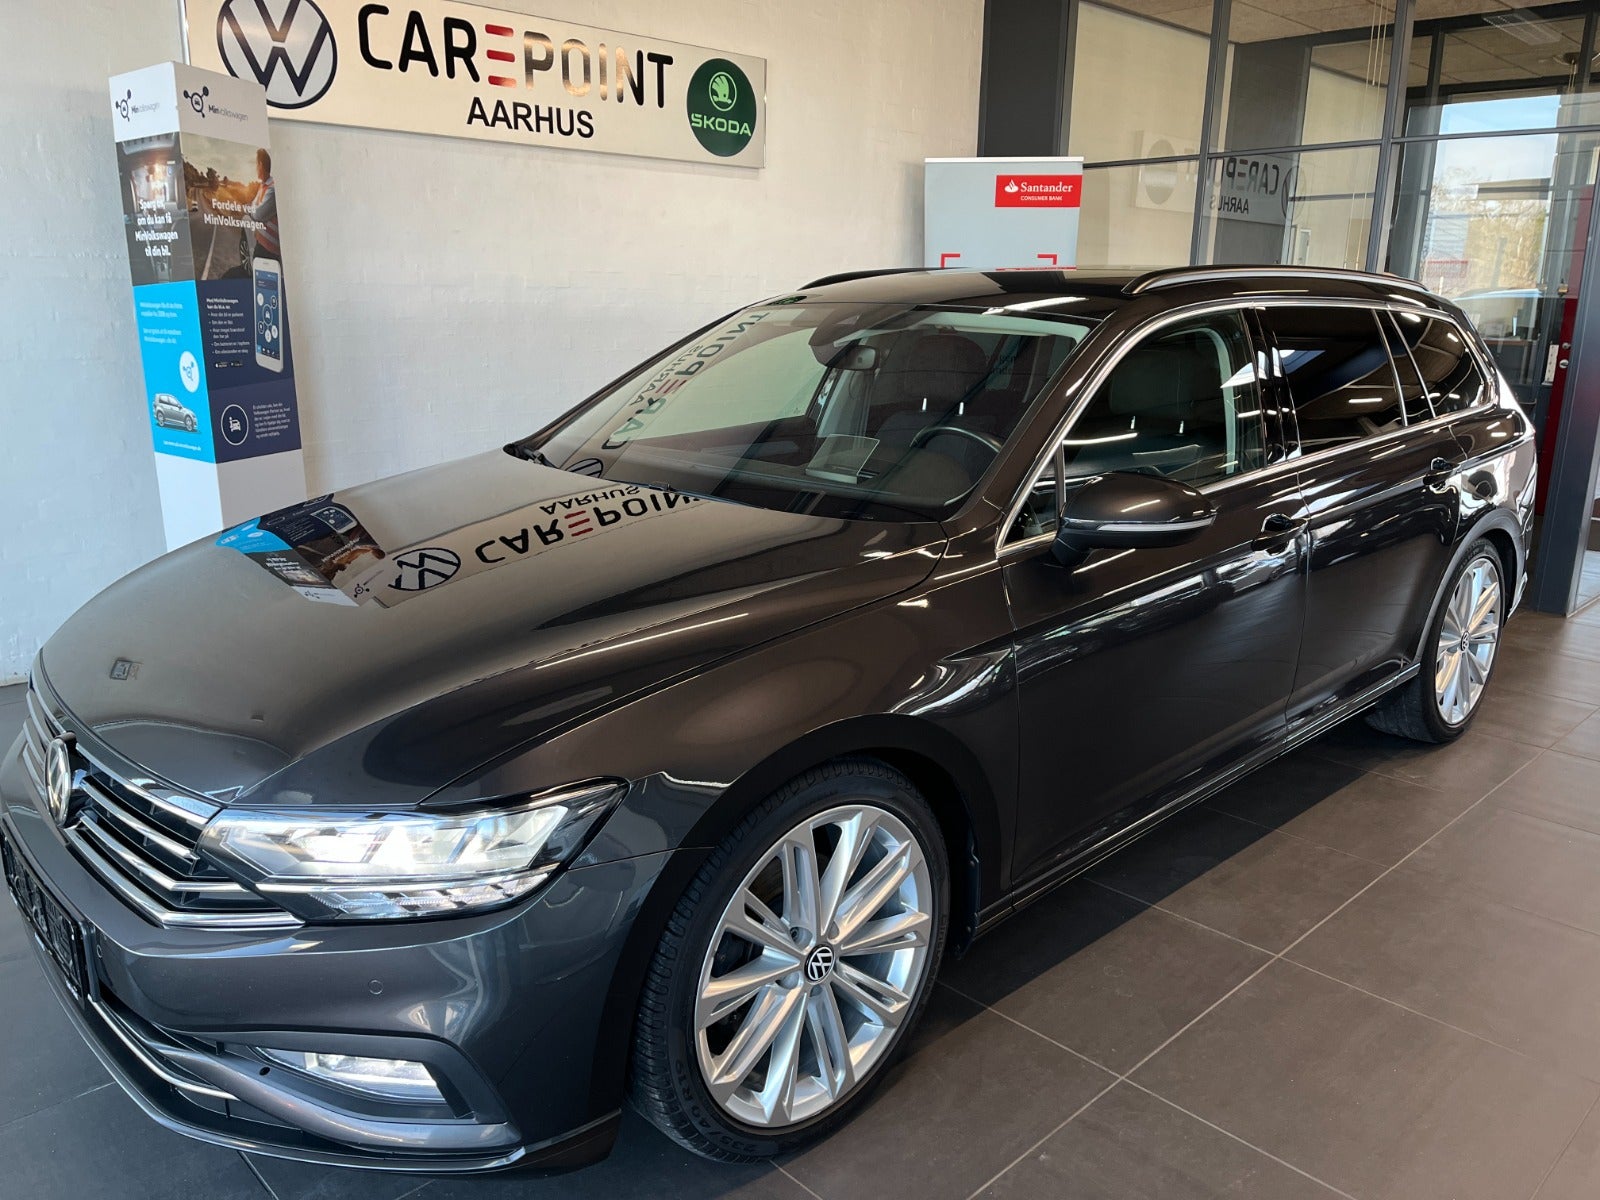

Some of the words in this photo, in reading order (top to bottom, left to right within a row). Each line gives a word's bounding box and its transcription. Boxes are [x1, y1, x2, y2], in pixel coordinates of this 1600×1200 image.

[358, 4, 674, 109] CAREPOINT
[466, 96, 595, 139] AARHUS
[1020, 181, 1073, 193] Santander
[211, 198, 242, 212] Fordele
[242, 203, 257, 214] ved
[137, 216, 147, 225] om
[147, 214, 154, 225] du
[154, 213, 166, 224] kan
[203, 213, 267, 232] MinVolkswagen.
[134, 230, 179, 242] MinVolkswagen
[151, 245, 161, 256] din
